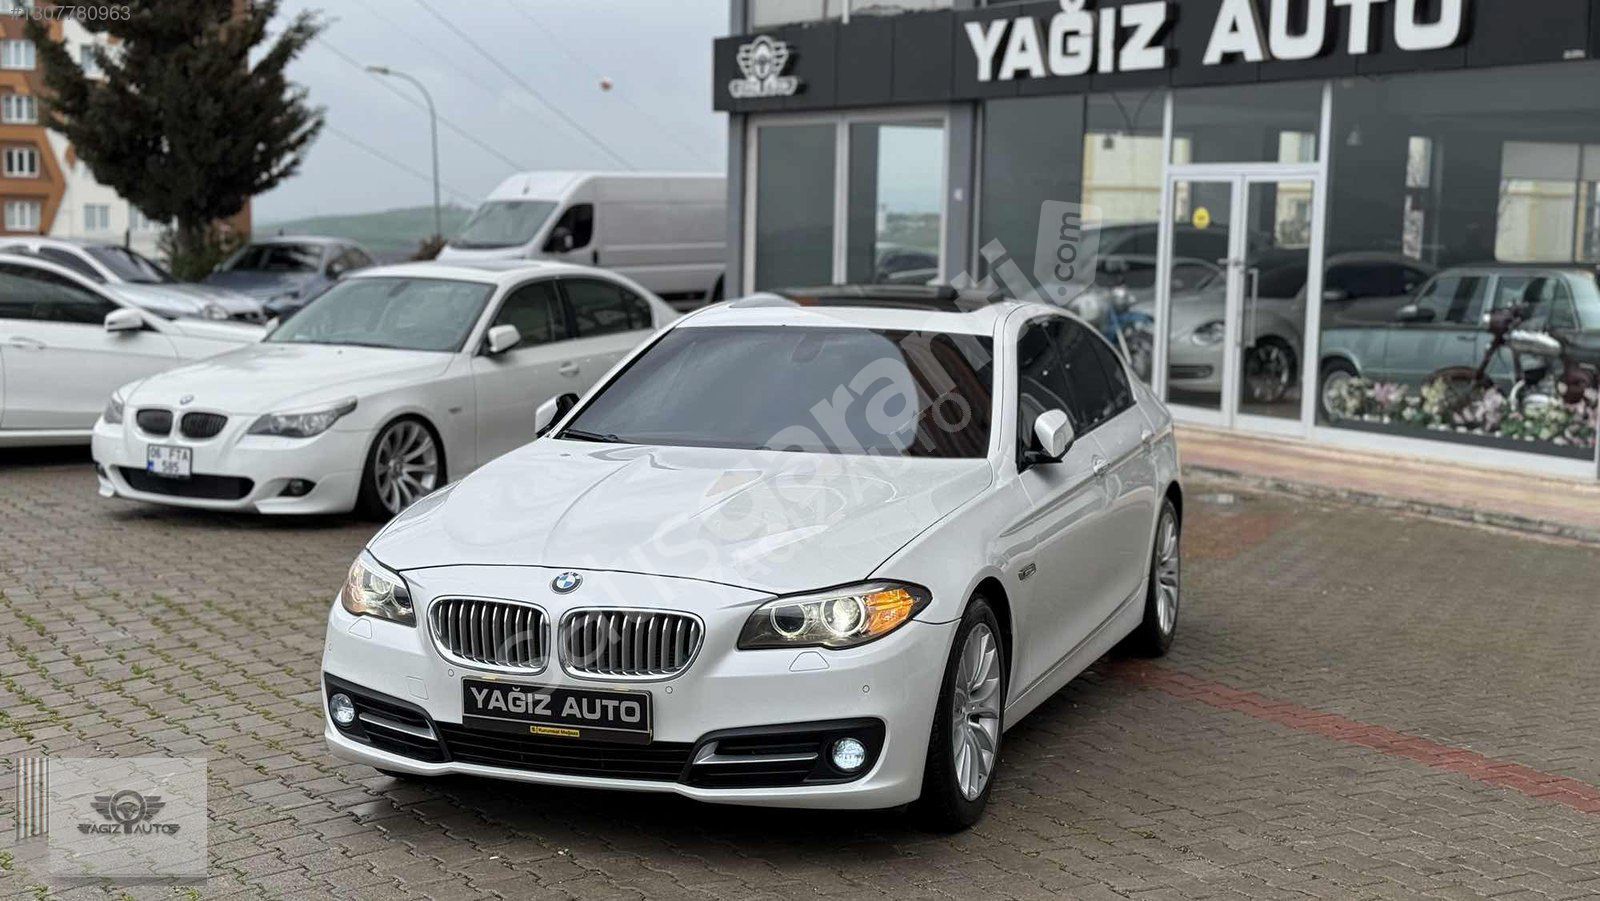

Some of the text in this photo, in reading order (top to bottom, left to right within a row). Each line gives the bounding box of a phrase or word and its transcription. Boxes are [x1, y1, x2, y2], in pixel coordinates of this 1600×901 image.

[964, 0, 1462, 82] YAĞIZ AUTO
[470, 686, 641, 723] YAĞIZ AUTO
